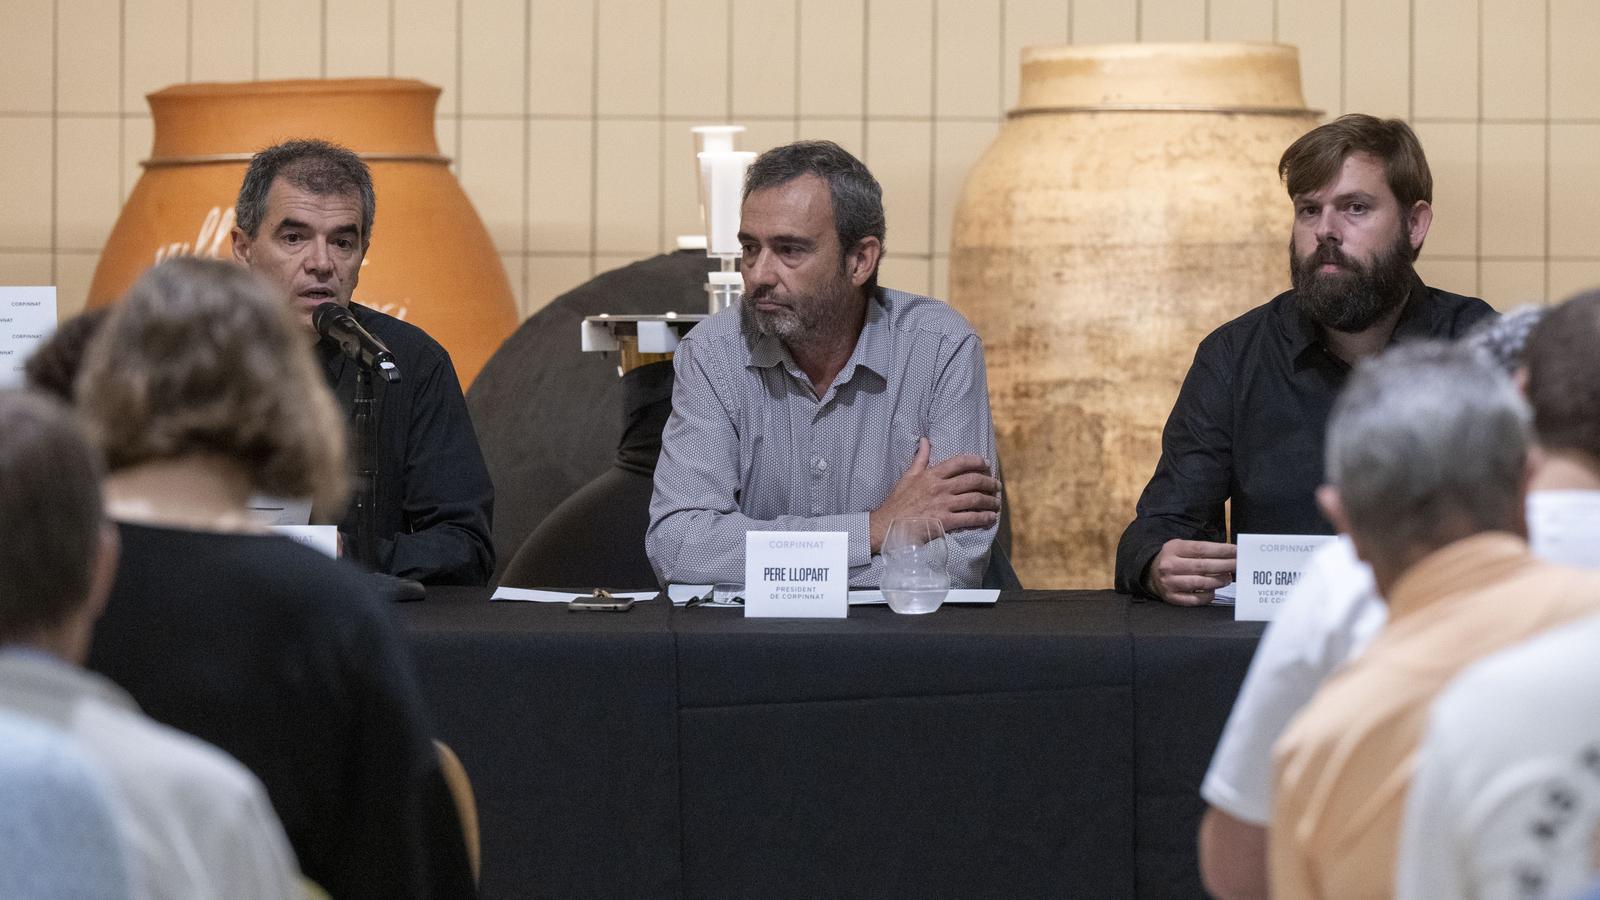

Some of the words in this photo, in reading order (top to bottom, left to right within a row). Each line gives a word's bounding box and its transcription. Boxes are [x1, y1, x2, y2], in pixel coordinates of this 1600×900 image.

[769, 541, 825, 549] CORPINNAT
[1260, 544, 1315, 552] CORPINNAT
[764, 567, 787, 581] PERE
[789, 567, 829, 582] LLOPART
[1252, 571, 1272, 585] ROC
